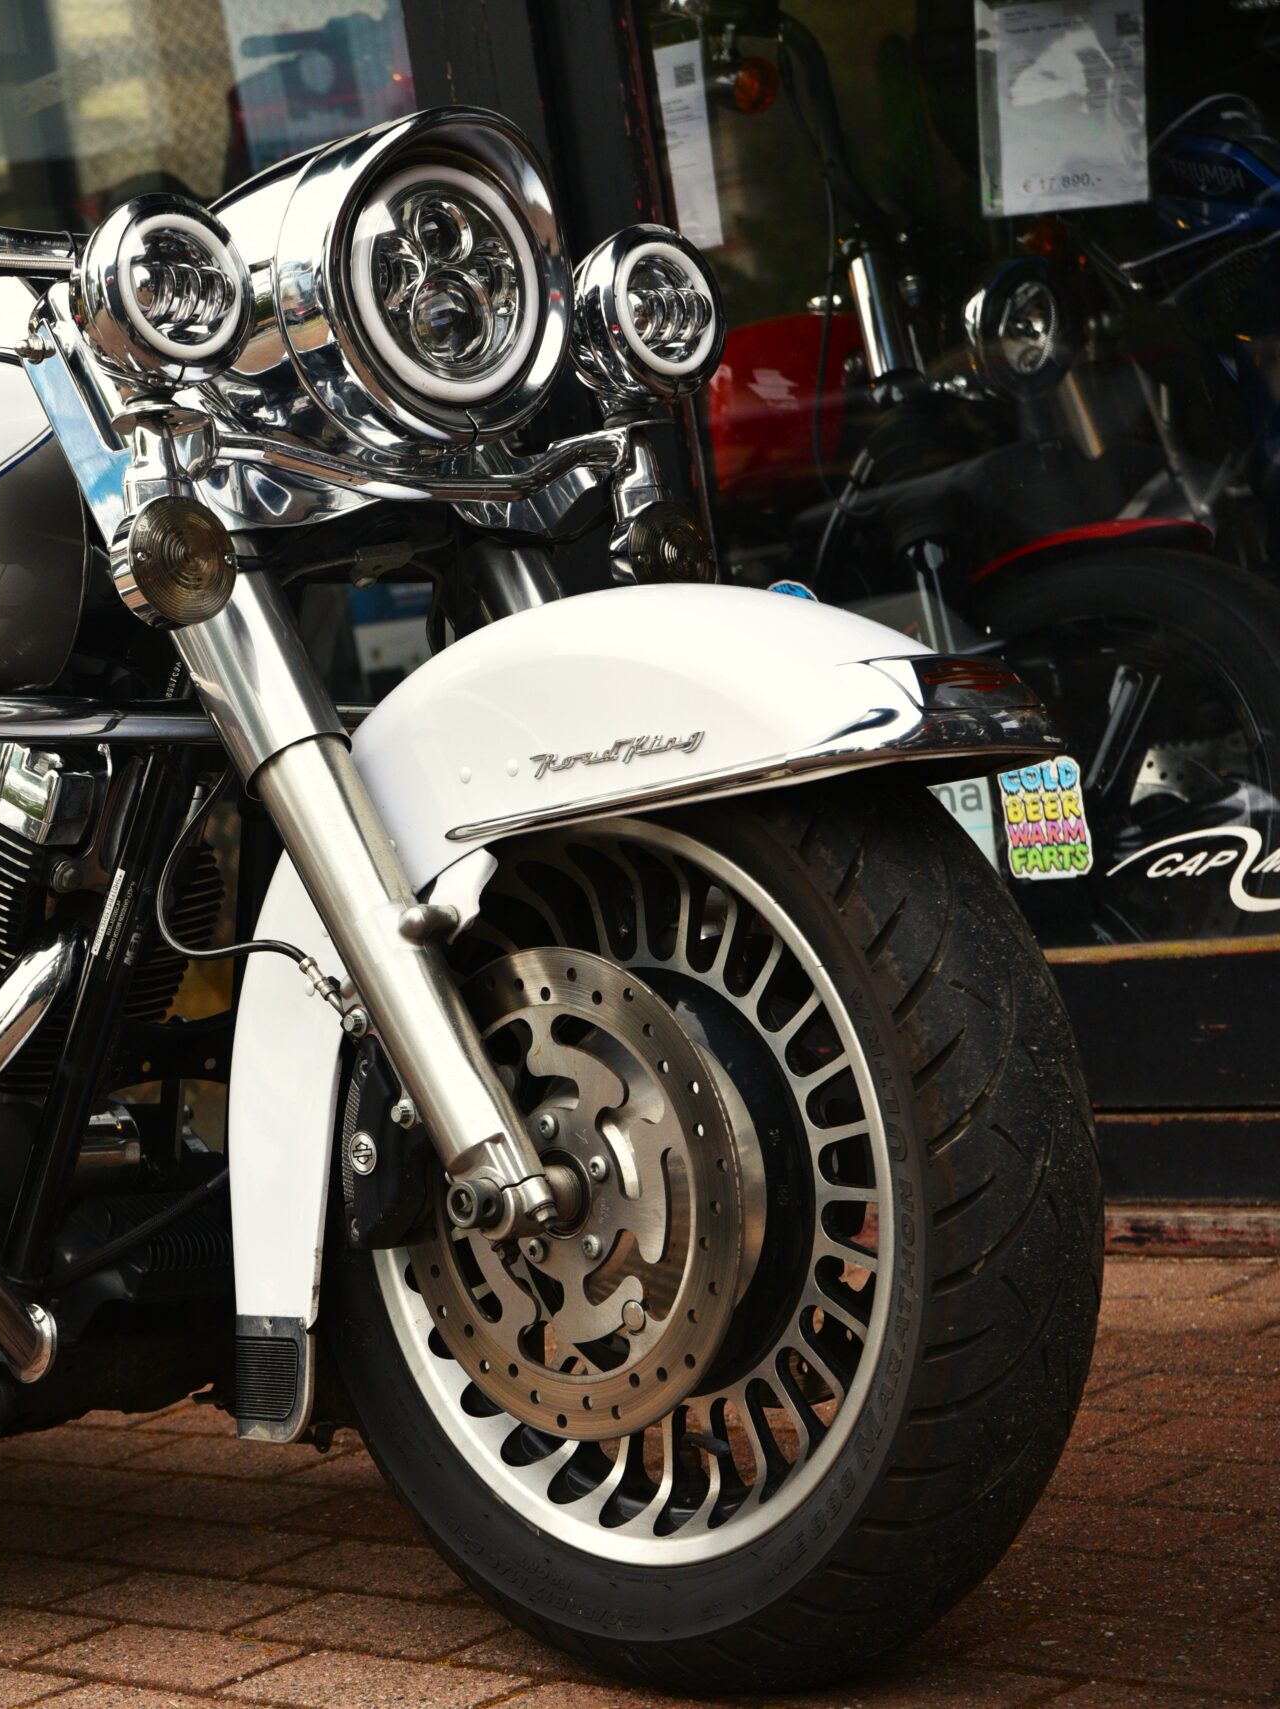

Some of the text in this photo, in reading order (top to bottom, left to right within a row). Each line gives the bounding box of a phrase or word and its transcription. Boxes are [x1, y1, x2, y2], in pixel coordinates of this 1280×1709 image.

[1170, 160, 1247, 192] TRIUMPH
[613, 730, 706, 765] King
[1000, 758, 1079, 795] COLD
[1005, 789, 1082, 824] BEER
[1007, 817, 1088, 850] WARM
[1010, 842, 1090, 875] FARTS
[1146, 849, 1239, 879] CAP
